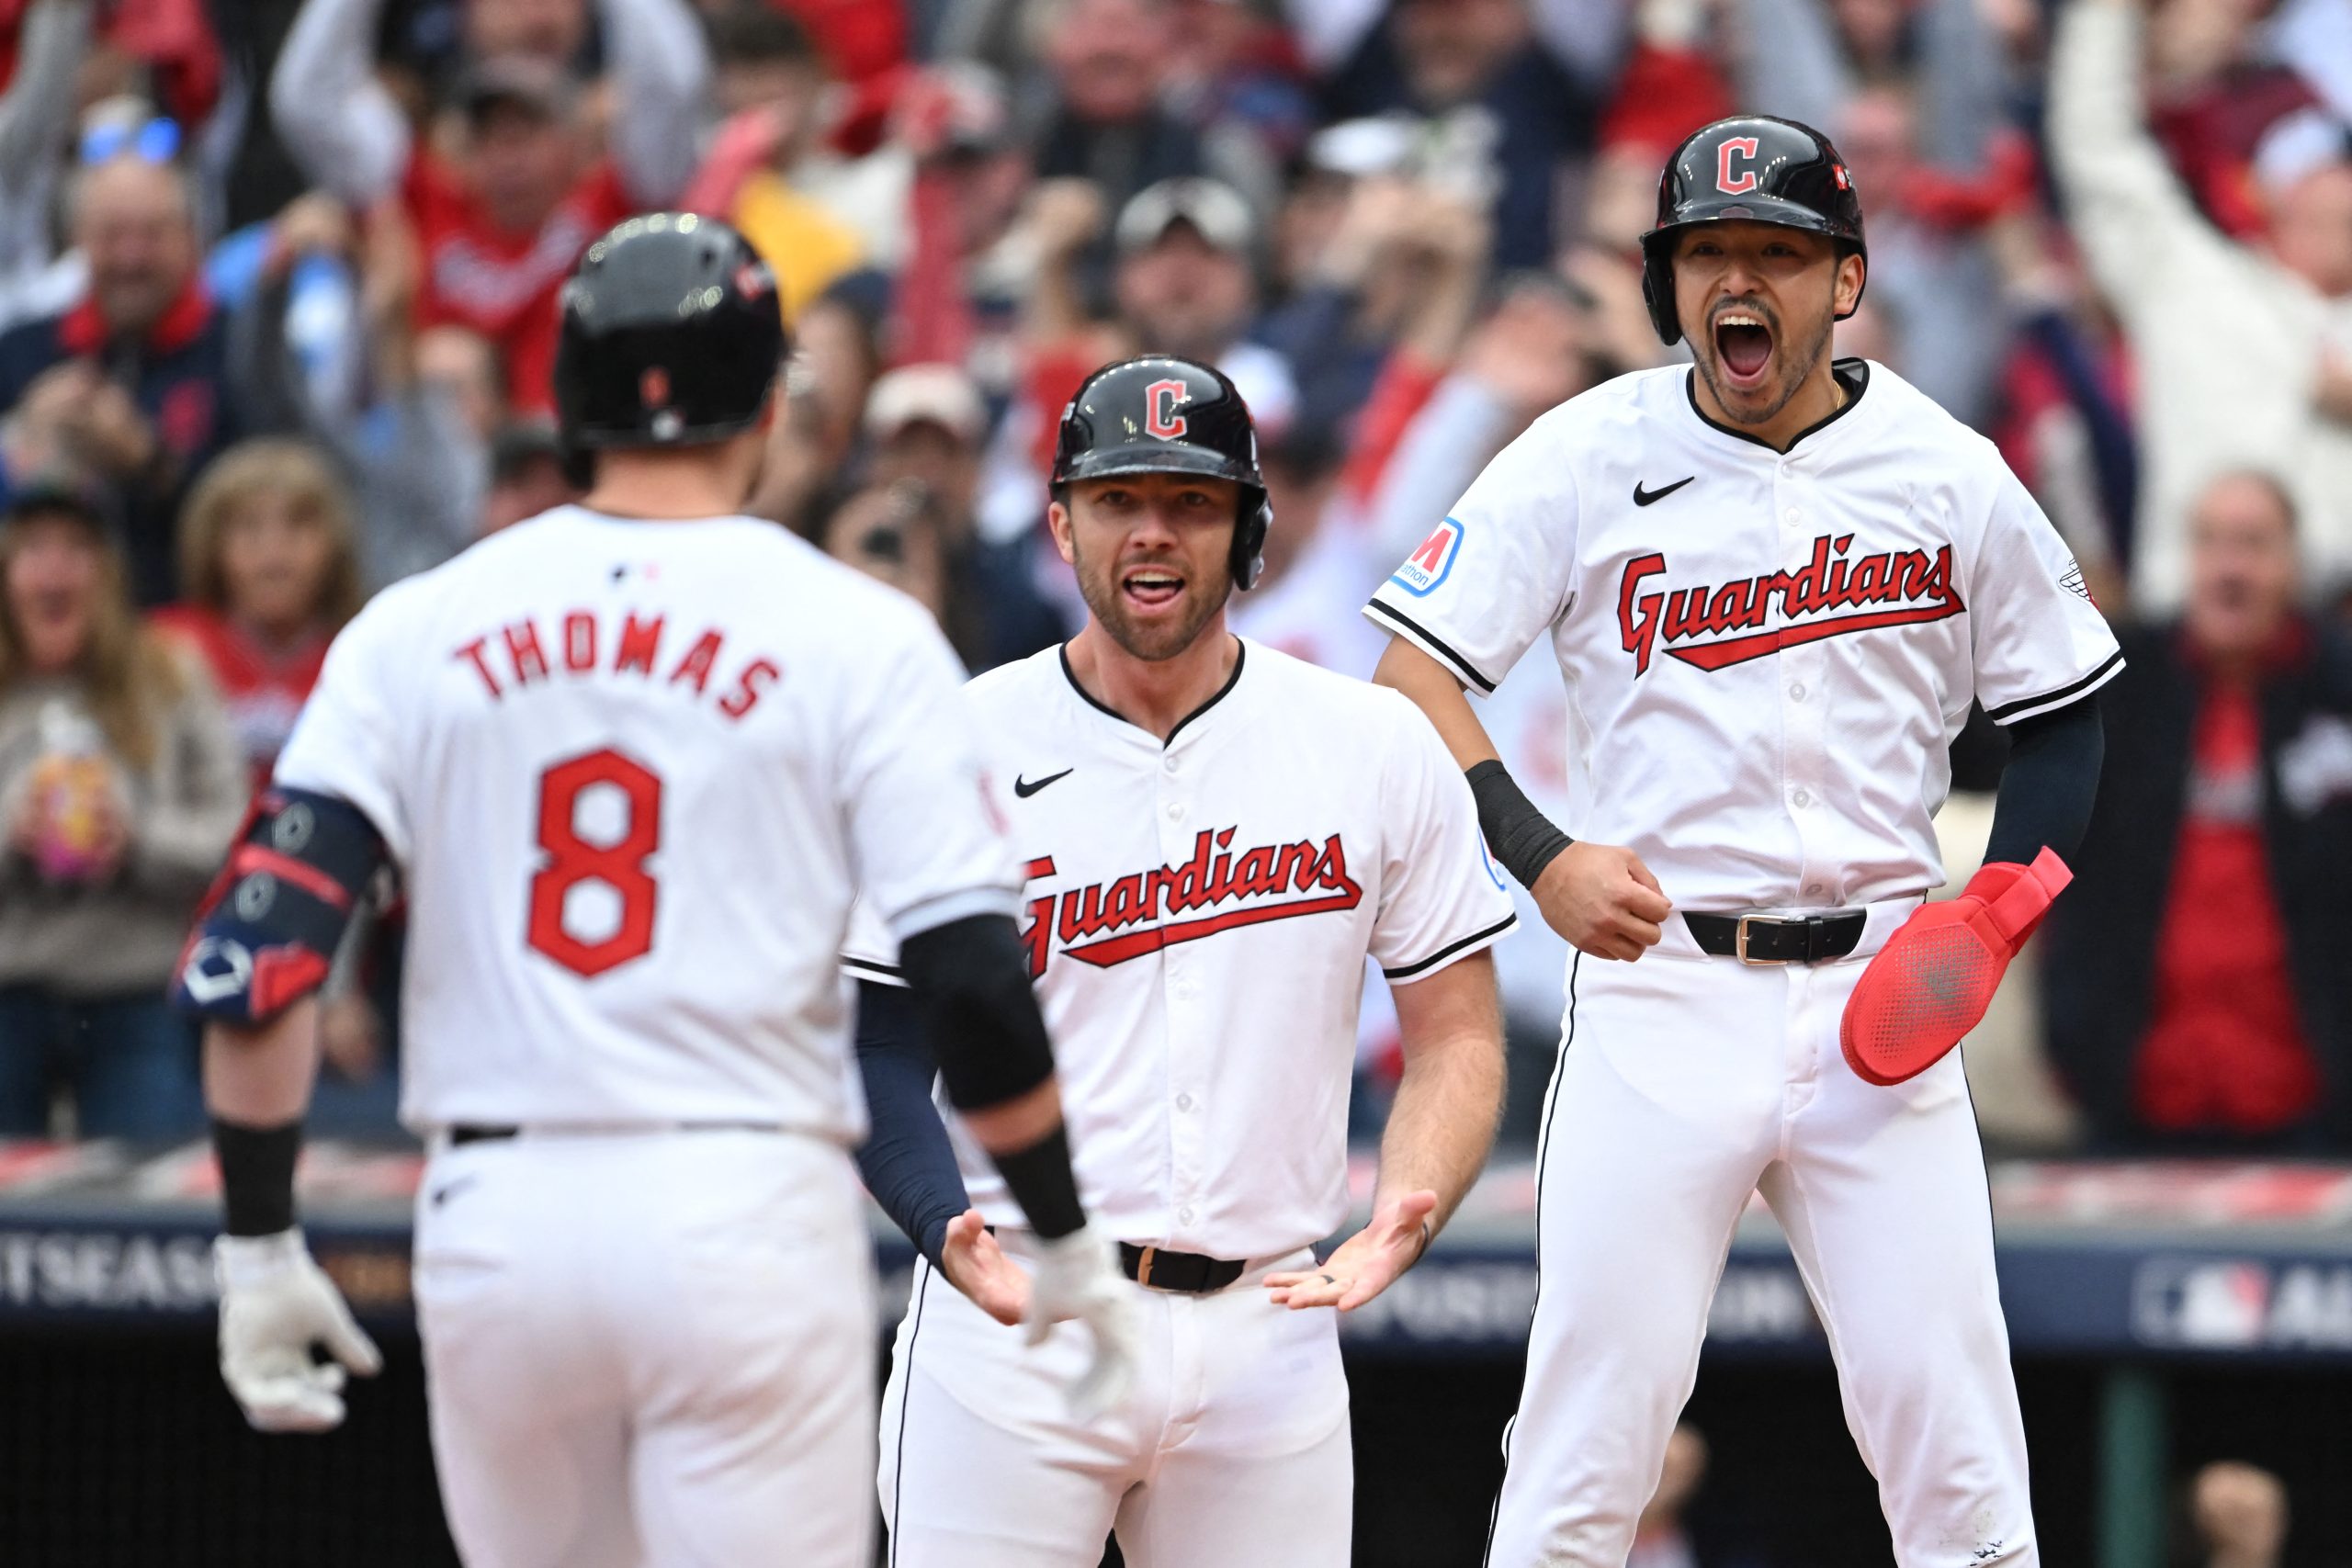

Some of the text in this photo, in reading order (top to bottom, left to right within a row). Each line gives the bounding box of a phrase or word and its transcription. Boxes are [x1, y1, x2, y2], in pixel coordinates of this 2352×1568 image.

[1716, 137, 1758, 196] C
[1146, 378, 1188, 441] C
[1617, 534, 1966, 681] Guardians
[456, 610, 780, 722] THOMAS
[526, 749, 662, 979] 8
